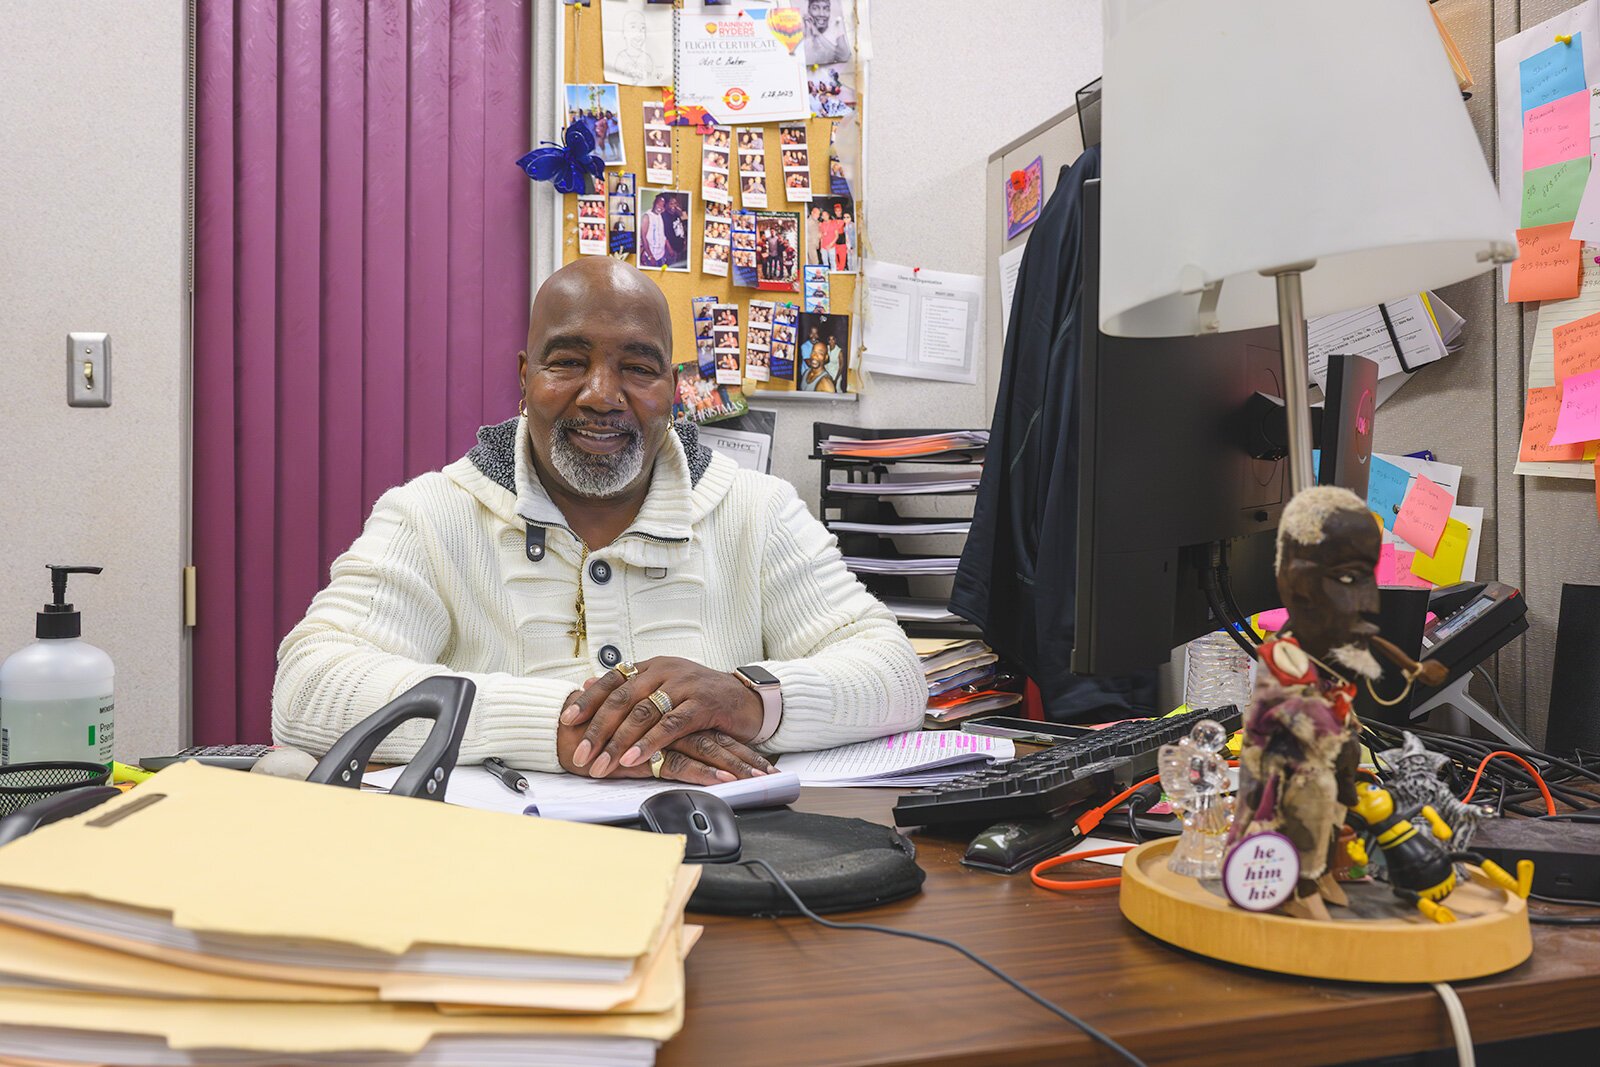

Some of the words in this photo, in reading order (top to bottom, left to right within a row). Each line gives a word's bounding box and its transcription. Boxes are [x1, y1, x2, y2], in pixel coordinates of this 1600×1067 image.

[718, 28, 755, 36] RYDERS
[685, 40, 716, 50] FLIGHT
[719, 39, 777, 50] CERTIFICATE
[1254, 845, 1276, 859] he
[1245, 866, 1281, 880] him
[1248, 885, 1276, 900] his
